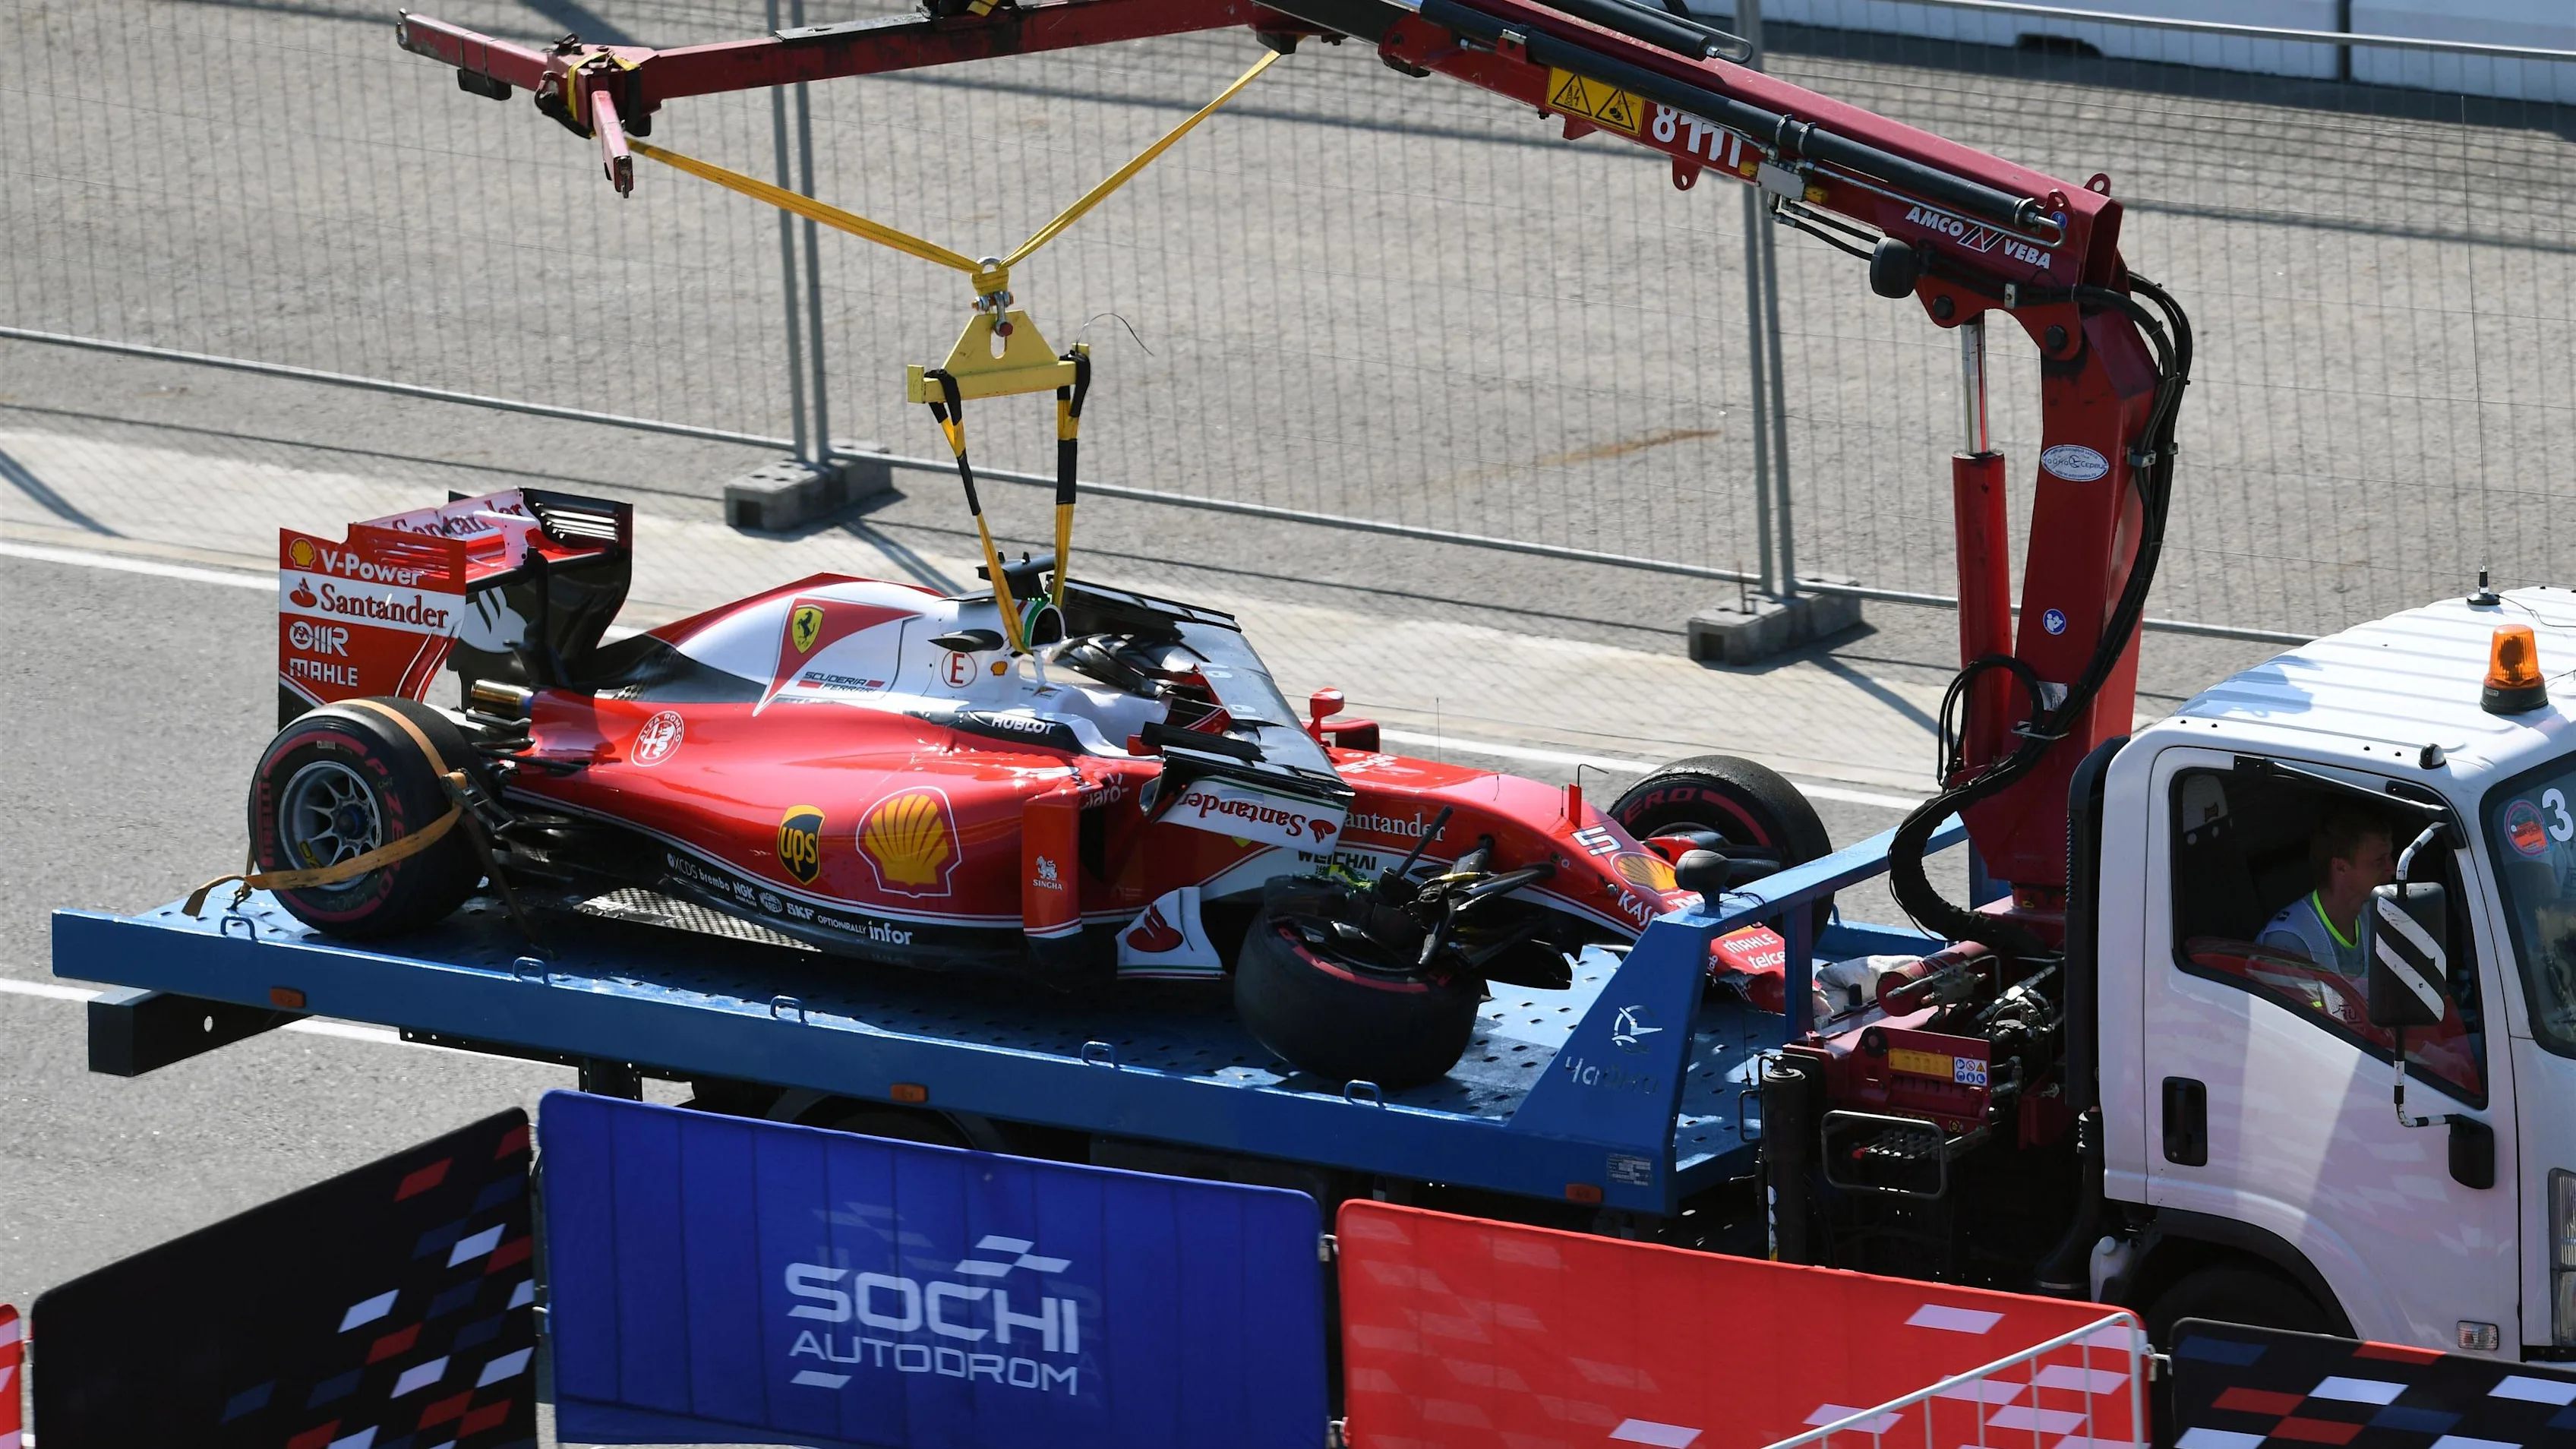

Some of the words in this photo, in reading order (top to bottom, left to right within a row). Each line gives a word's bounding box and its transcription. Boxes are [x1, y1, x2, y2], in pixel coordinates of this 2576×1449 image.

[1905, 207, 1964, 237] AMCO
[2004, 239, 2051, 269] VEBA
[320, 548, 421, 586] V-Power
[320, 582, 449, 629] Santander
[289, 658, 358, 687] MAHLE
[803, 671, 867, 686] SCUDERIA
[951, 652, 965, 683] E
[821, 683, 877, 693] FERRARI
[639, 717, 660, 742] ALFA
[664, 714, 681, 742] ROMEO
[991, 717, 1056, 735] HUBLOT
[1179, 792, 1306, 836] Santander
[1615, 788, 1697, 826] ERO
[2542, 788, 2574, 842] 3
[1345, 812, 1445, 841] antander
[779, 826, 817, 873] ups
[1298, 851, 1377, 870] WEICHAI
[698, 868, 731, 892] brembo
[732, 880, 756, 901] NGK
[1033, 879, 1063, 891] SINGHA
[786, 902, 815, 921] SKF
[868, 920, 914, 945] infor
[1722, 933, 1778, 955] MAHLE
[784, 1262, 1080, 1354] SOCHI
[788, 1330, 1078, 1396] AUTODROM
